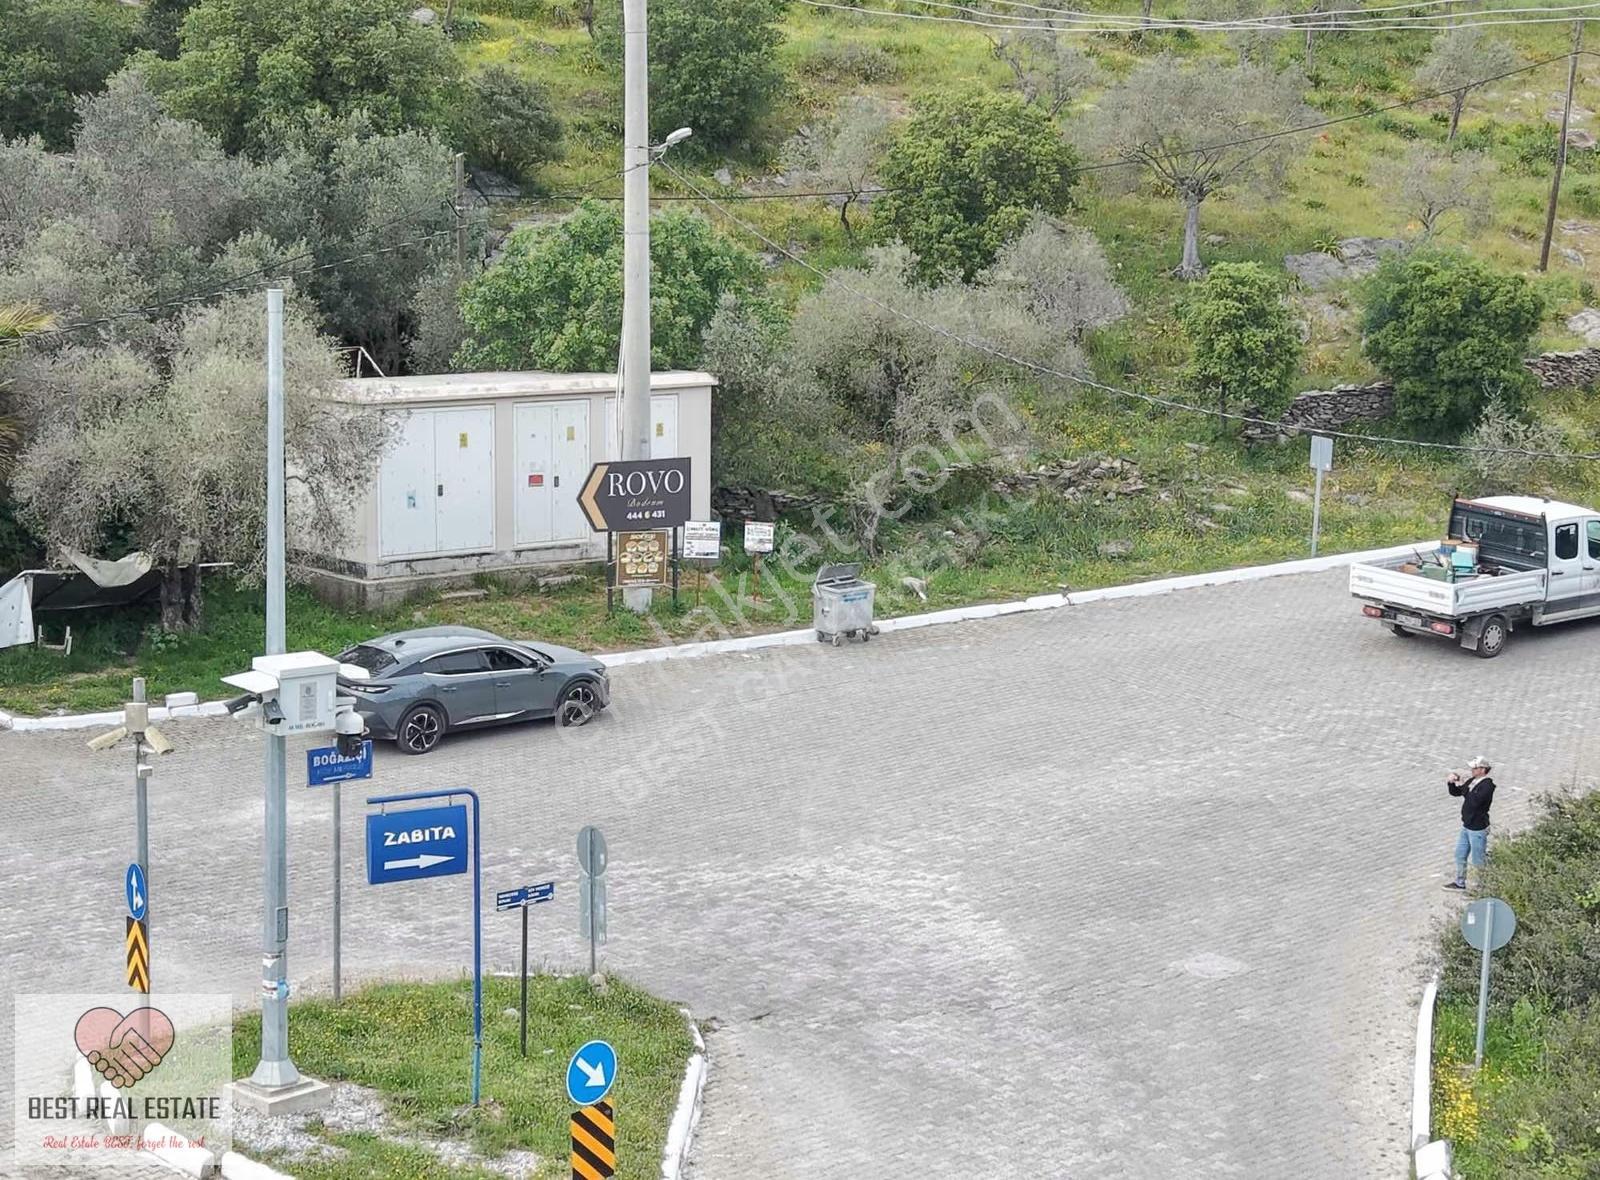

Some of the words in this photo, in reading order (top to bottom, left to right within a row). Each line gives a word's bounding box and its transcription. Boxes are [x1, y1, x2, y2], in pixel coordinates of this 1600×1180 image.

[608, 469, 684, 497] ROVO
[626, 512, 643, 520] 444
[644, 511, 651, 519] 6
[652, 510, 666, 518] 431
[313, 746, 367, 767] BOĞAÇİ
[384, 826, 456, 847] ZABITA
